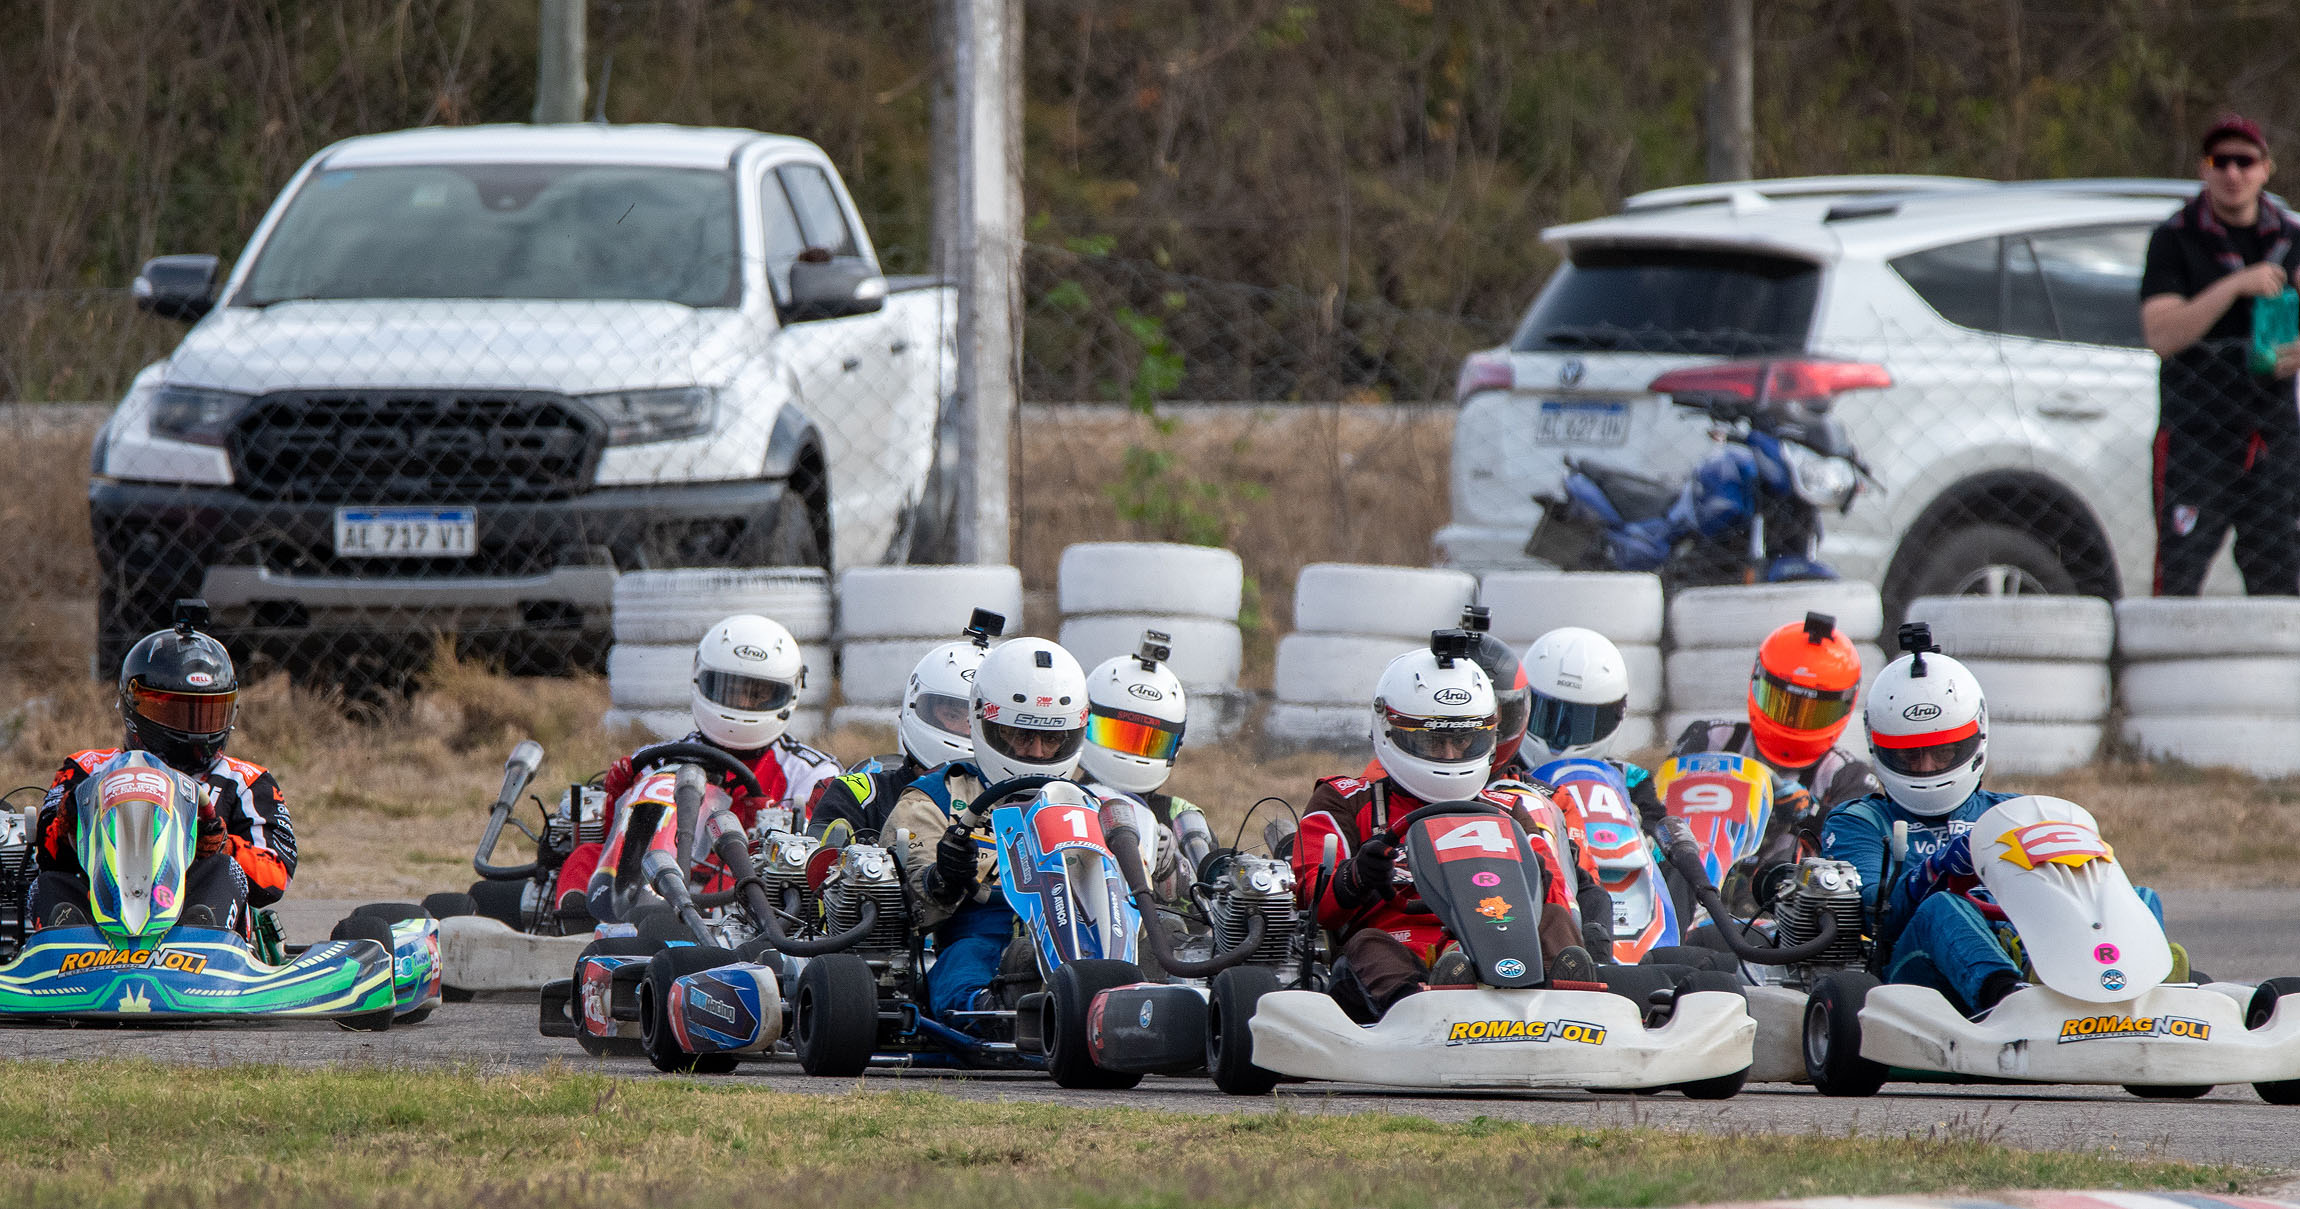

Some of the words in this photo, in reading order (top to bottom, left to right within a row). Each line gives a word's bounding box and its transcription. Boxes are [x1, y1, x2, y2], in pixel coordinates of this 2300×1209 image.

[1036, 696, 1053, 705] OMP
[1130, 684, 1159, 698] Arai
[1435, 689, 1469, 701] Arai
[1906, 704, 1938, 718] Arai
[1423, 719, 1484, 730] alpinestars
[104, 772, 167, 797] 29
[1681, 783, 1734, 815] 9
[1062, 809, 1089, 839] 1
[1434, 820, 1515, 853] 4
[1478, 874, 1494, 884] R
[1053, 896, 1068, 928] ATENOR
[60, 948, 208, 976] ROMAGNOLI
[2098, 947, 2117, 961] R
[1449, 1018, 1608, 1046] ROMAGNOLI
[2060, 1014, 2212, 1041] ROMAGNOLI
